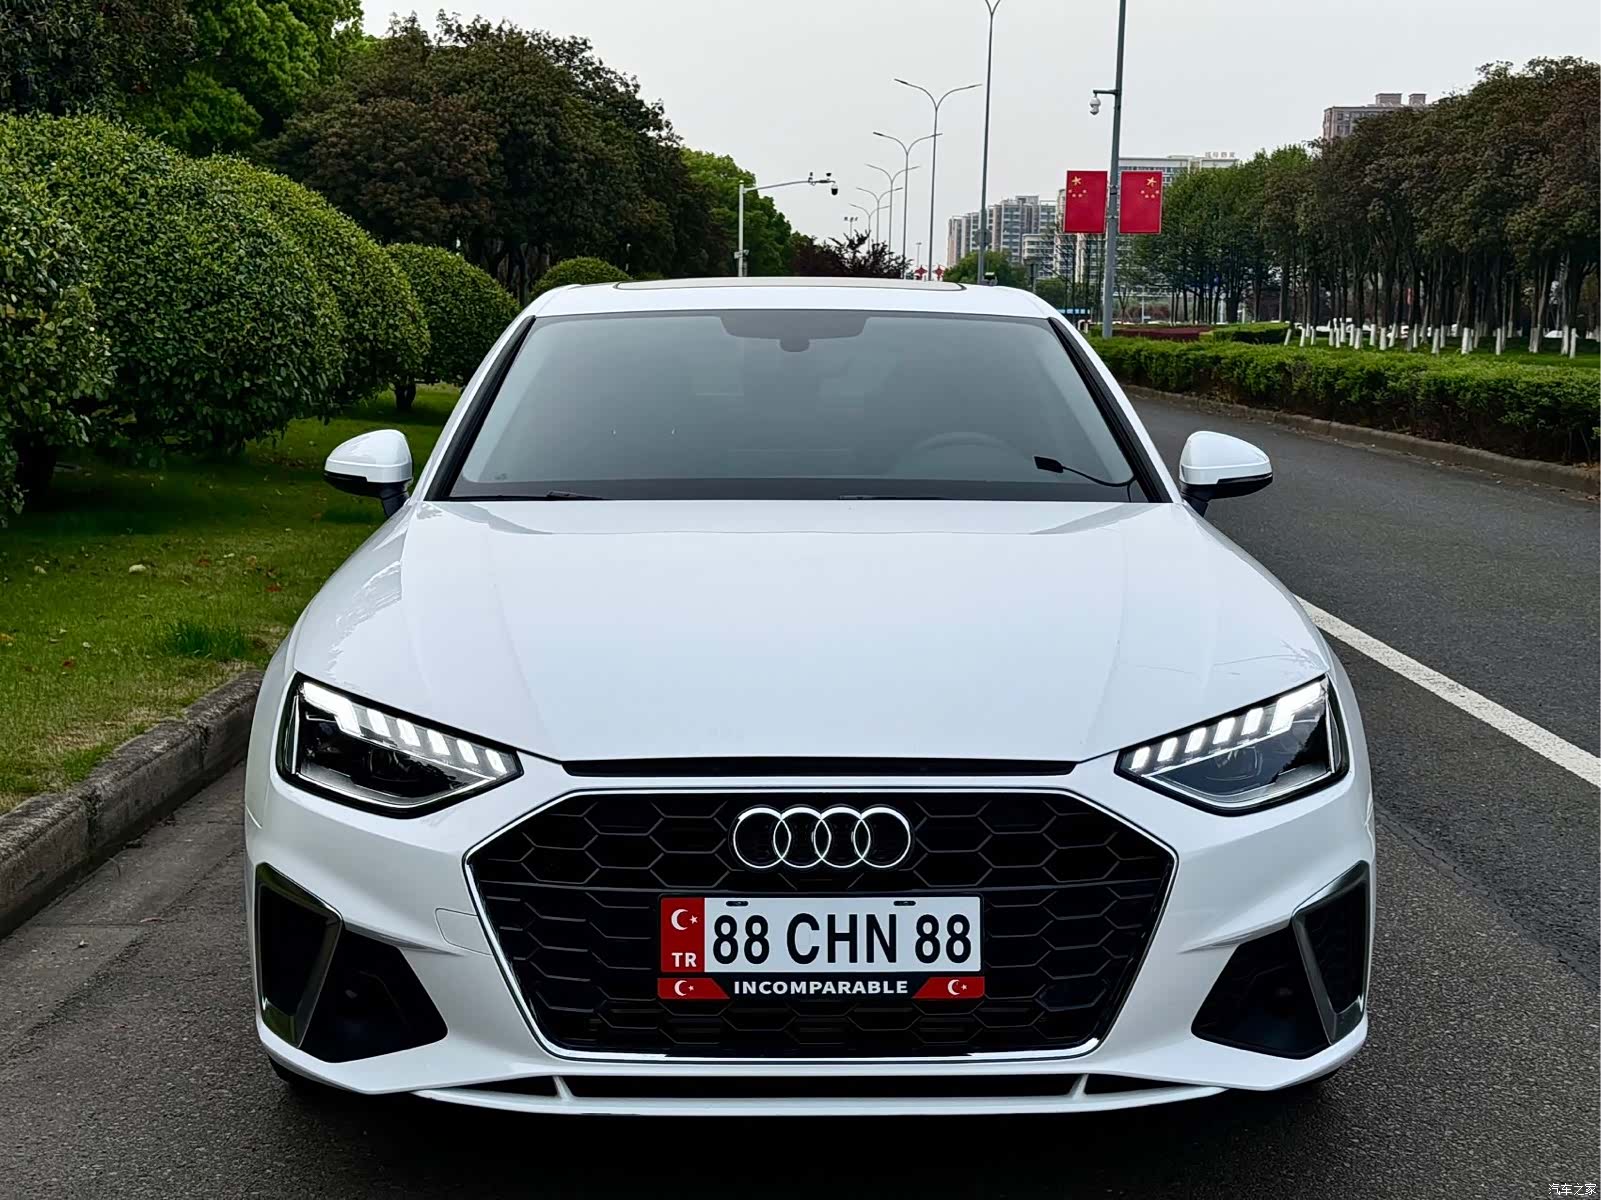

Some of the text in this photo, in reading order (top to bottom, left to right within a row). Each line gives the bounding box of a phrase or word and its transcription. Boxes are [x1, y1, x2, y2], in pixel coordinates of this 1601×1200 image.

[712, 912, 972, 965] 88 CHN 88
[671, 952, 697, 967] TR
[733, 980, 908, 994] INCOMPARABLE
